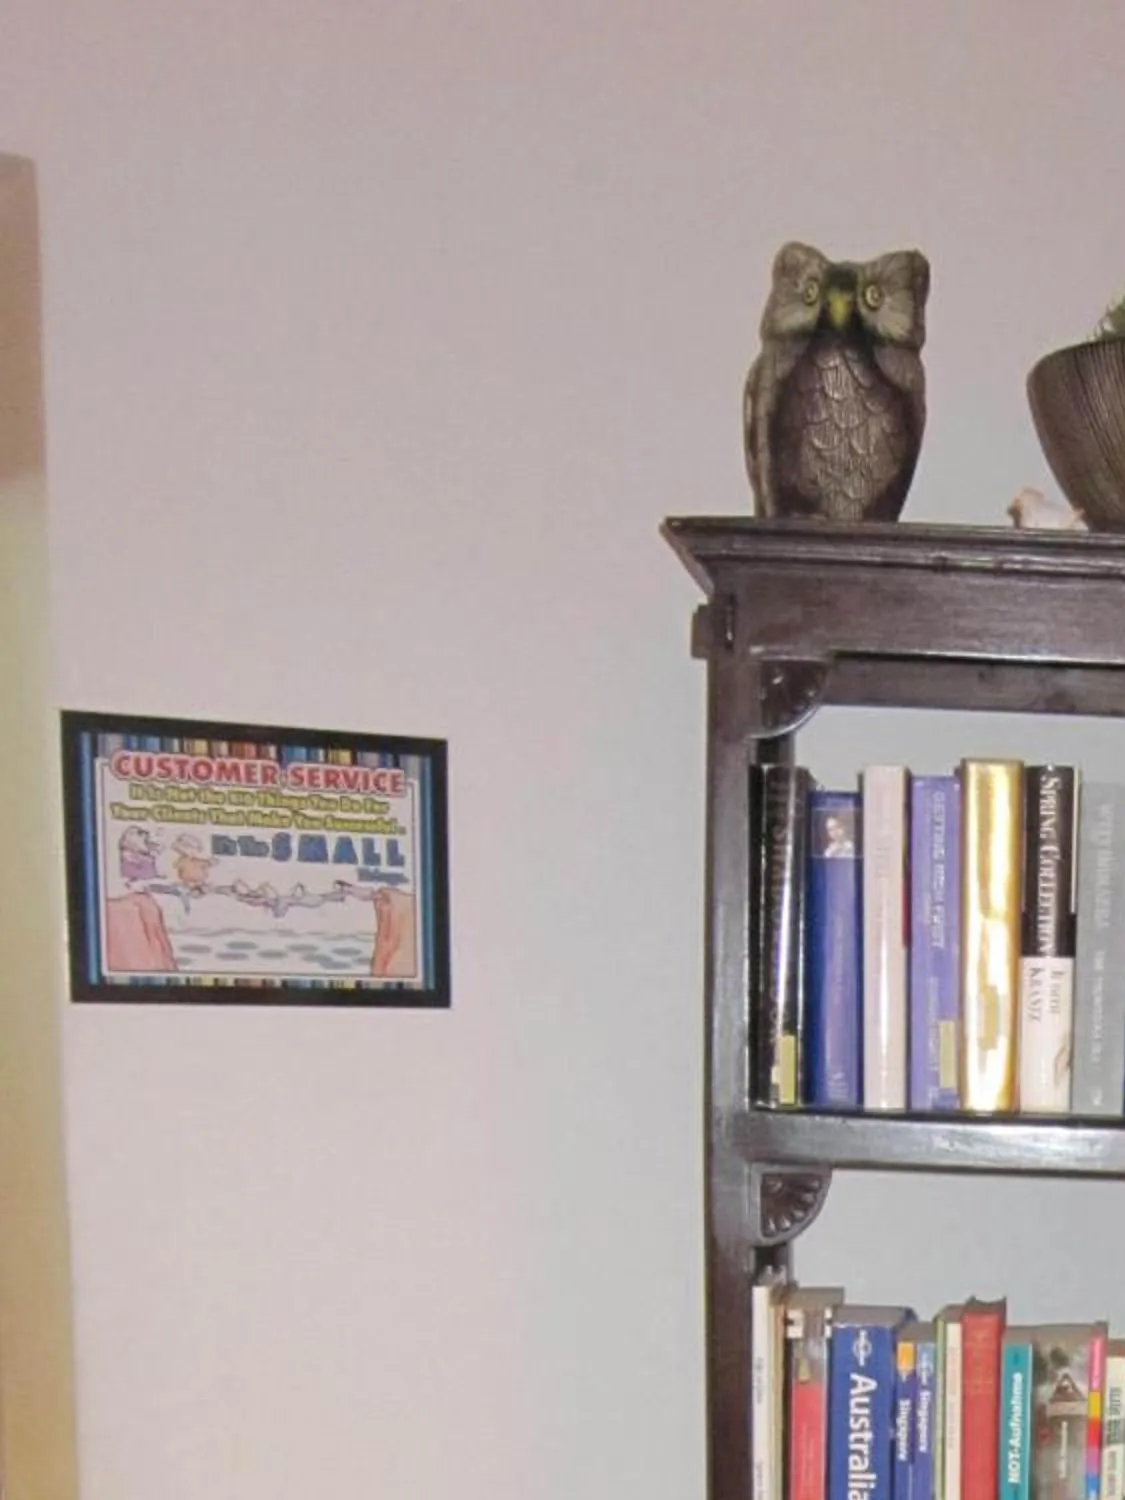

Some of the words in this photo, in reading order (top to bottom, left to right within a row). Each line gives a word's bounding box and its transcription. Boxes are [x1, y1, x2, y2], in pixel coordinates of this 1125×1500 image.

[113, 754, 279, 787] CUSTOMER
[288, 764, 406, 794] SERVICE
[1039, 775, 1064, 838] SPRING
[271, 832, 405, 867] SMALL
[1037, 844, 1062, 956] COLLECTION
[897, 1399, 911, 1461] Singapore
[917, 1390, 931, 1453] Singapore
